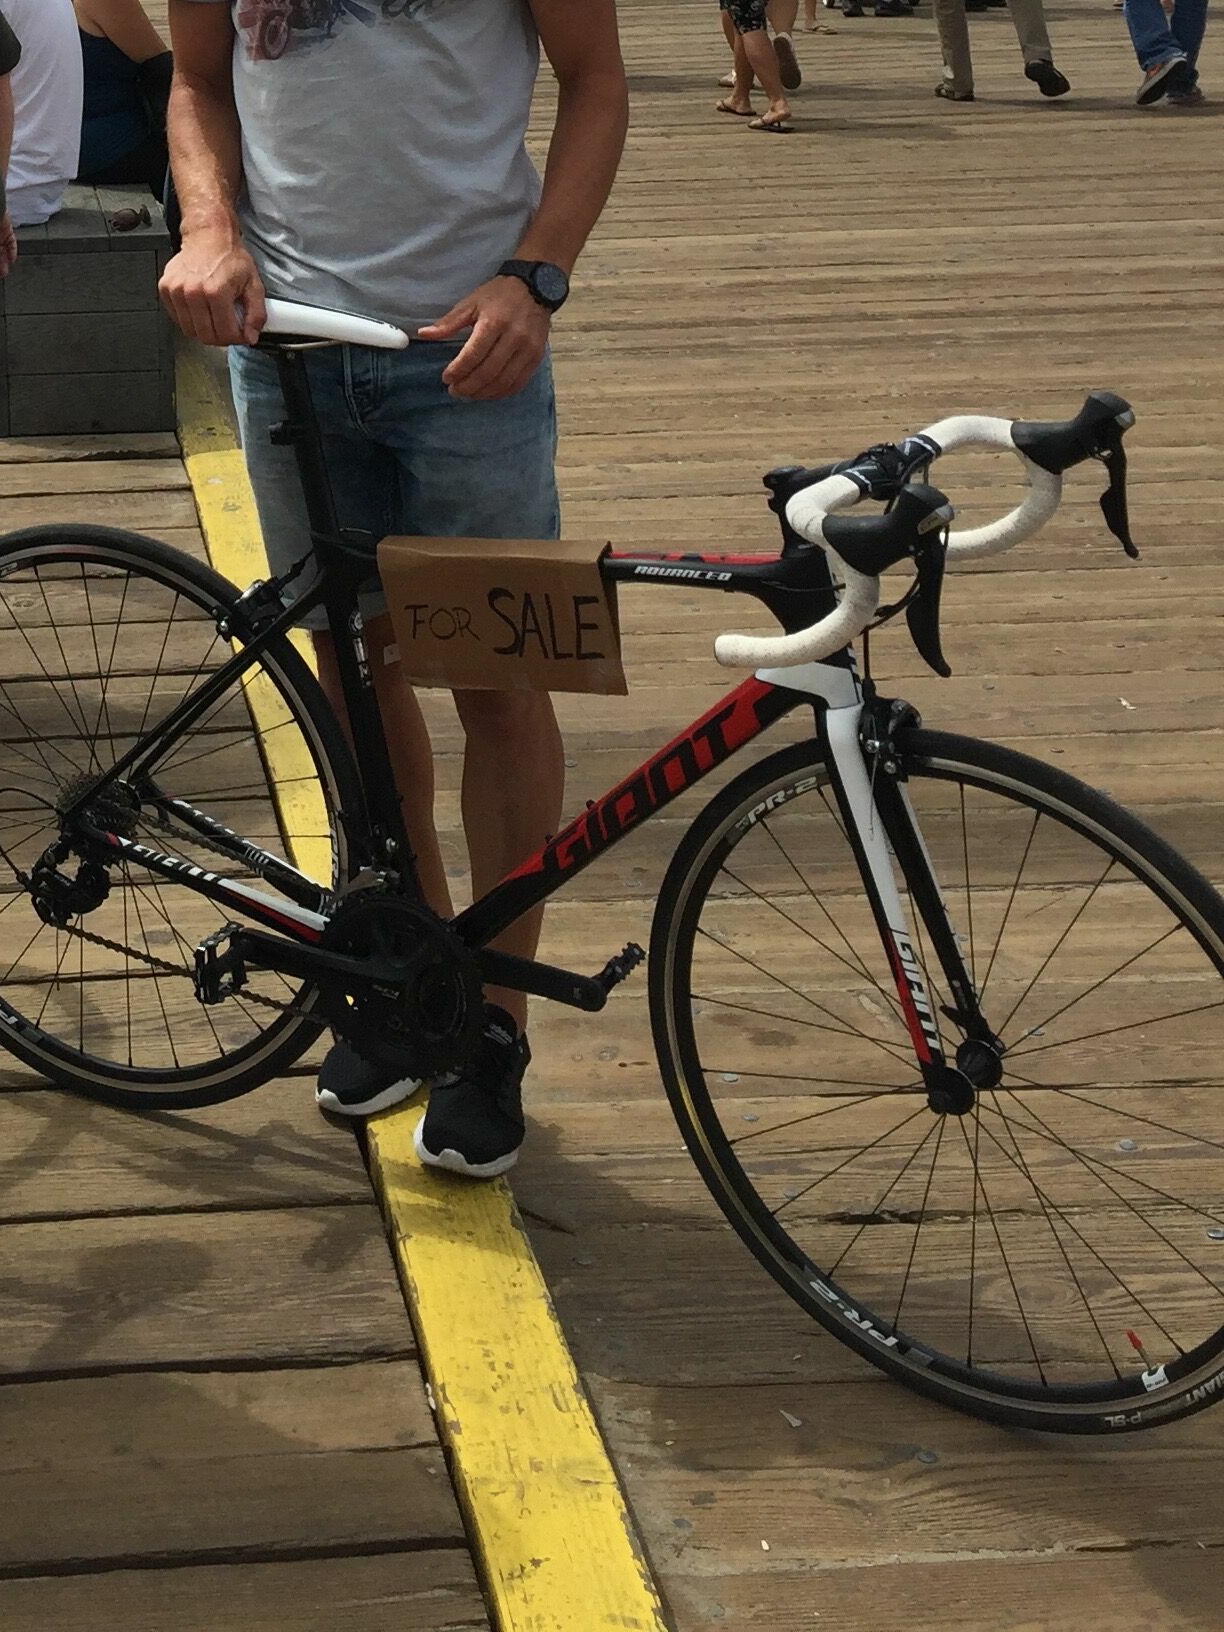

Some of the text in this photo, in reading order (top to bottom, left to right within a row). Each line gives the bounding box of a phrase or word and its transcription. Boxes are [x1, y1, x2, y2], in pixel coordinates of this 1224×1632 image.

[634, 565, 733, 582] ADVANCED
[405, 587, 606, 660] FOR SALE
[542, 699, 740, 875] GIANT
